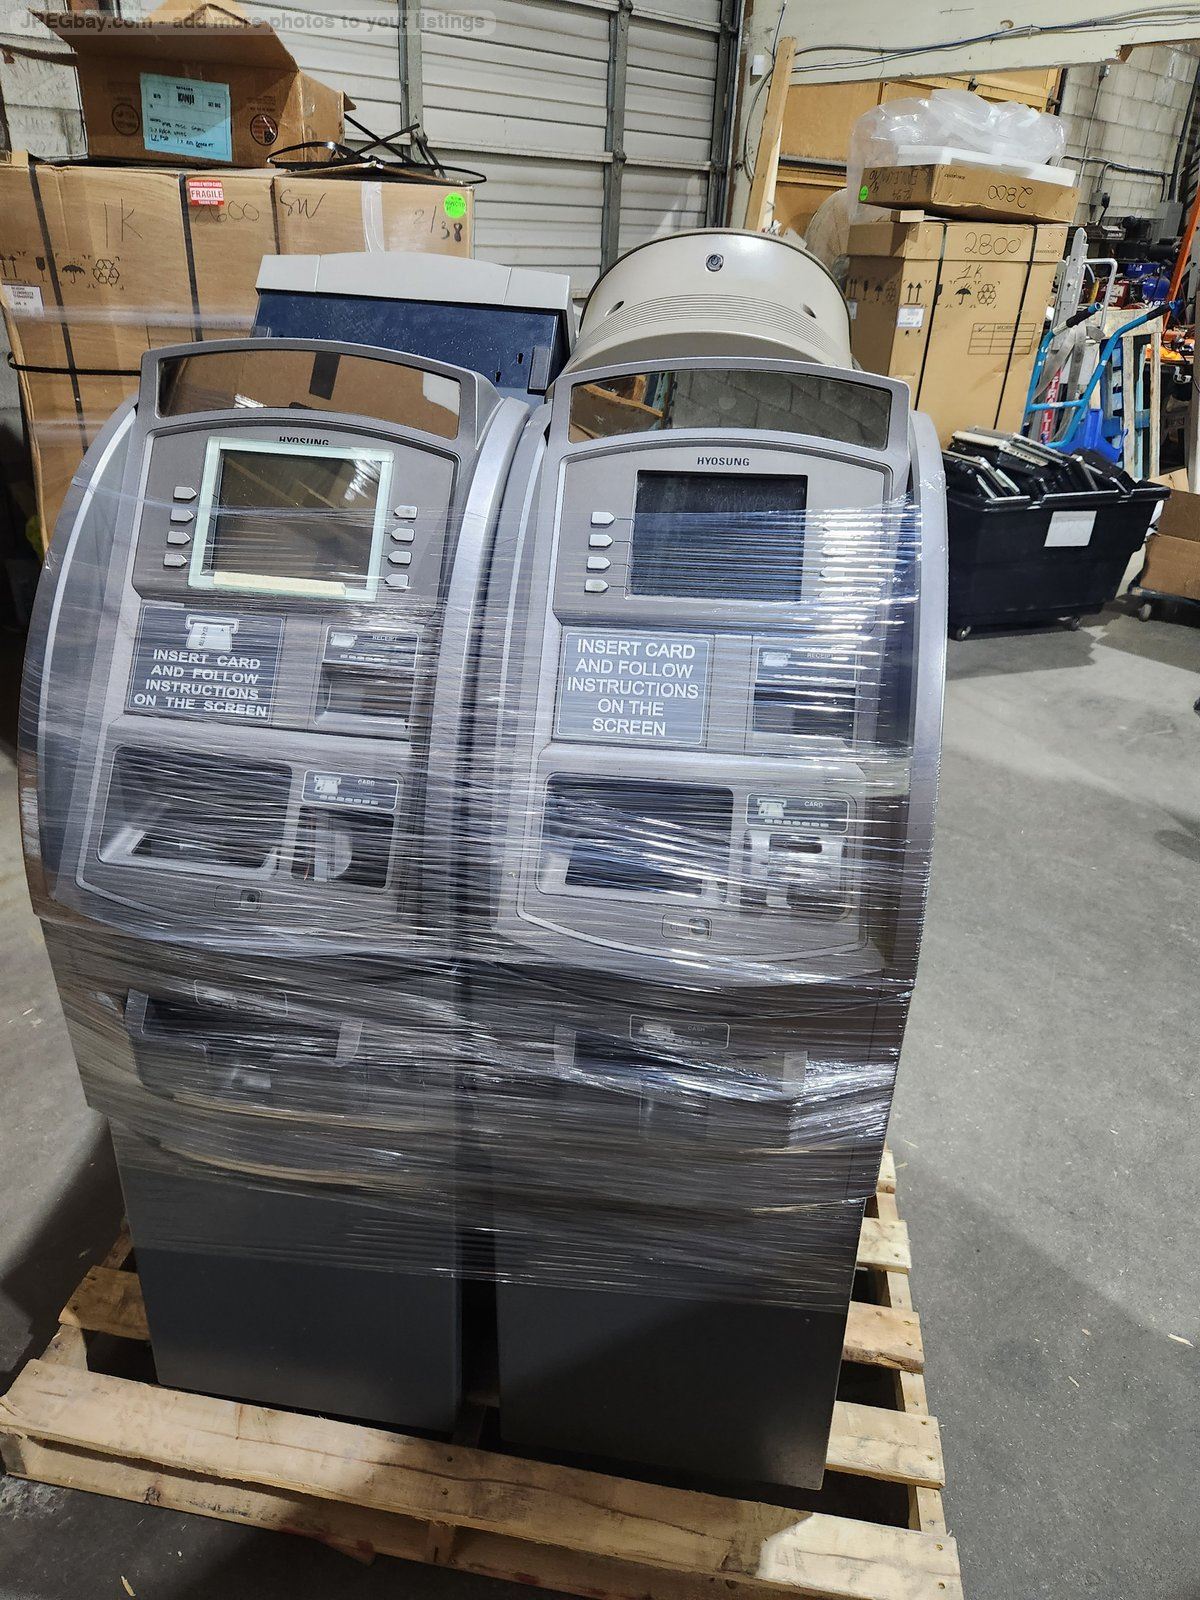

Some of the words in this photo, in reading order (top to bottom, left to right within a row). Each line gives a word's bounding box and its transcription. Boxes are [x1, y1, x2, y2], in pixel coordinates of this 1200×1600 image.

[191, 189, 224, 199] FRAGILE
[964, 231, 1022, 256] 2800
[279, 436, 329, 446] HYOSUNG
[697, 456, 750, 467] HYOSUNG
[577, 638, 642, 656] INSERT
[645, 642, 696, 659] CARD
[153, 649, 209, 664] INSERT
[217, 655, 261, 670] CARD
[575, 658, 613, 674] AND
[618, 659, 694, 679] FOLLOW
[150, 664, 185, 677] AND
[192, 668, 259, 685] FOLLOW
[145, 679, 259, 700] INSTRUCTIONS
[567, 676, 699, 699] INSTRUCTIONS
[134, 693, 157, 706] ON
[165, 696, 196, 710] THE
[203, 700, 267, 717] SCREEN
[597, 698, 624, 714] ON
[629, 700, 665, 717] THE
[592, 717, 666, 737] SCREEN
[804, 800, 824, 808] CARD
